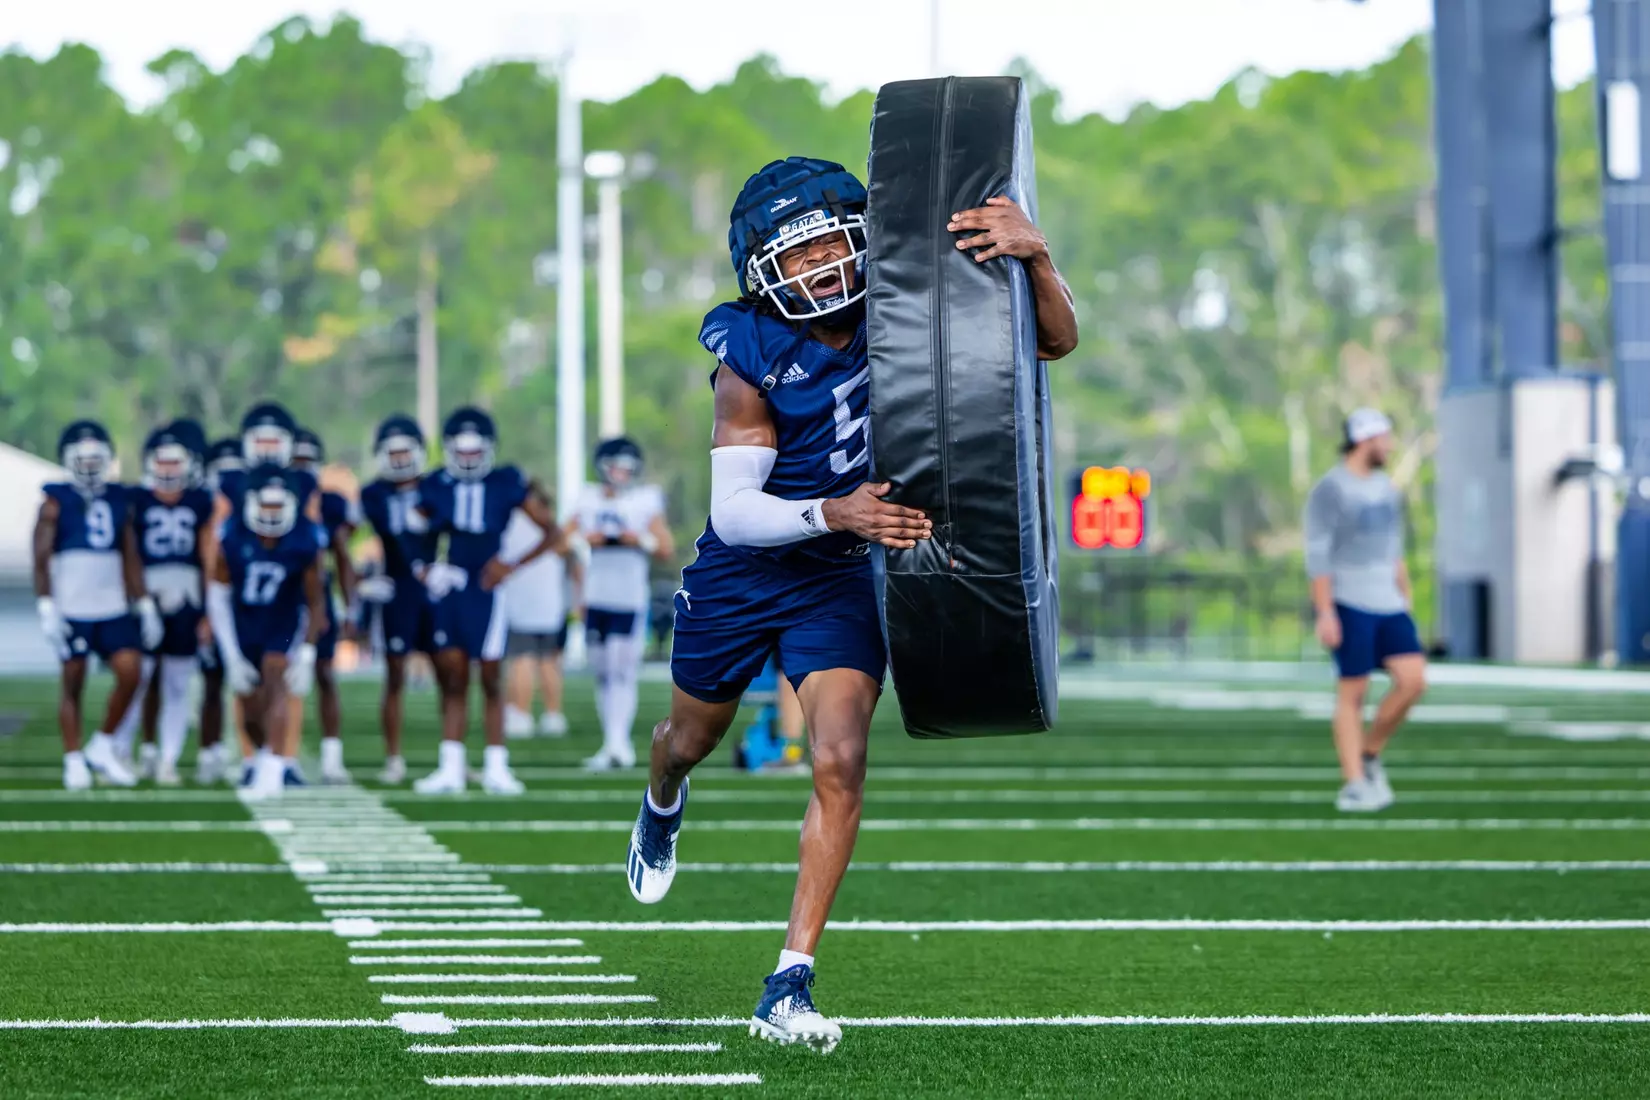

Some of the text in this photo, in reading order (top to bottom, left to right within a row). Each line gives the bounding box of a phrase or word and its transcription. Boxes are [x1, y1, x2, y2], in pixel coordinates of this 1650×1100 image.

[791, 216, 815, 231] GATA
[781, 372, 810, 384] adidas
[86, 499, 114, 549] 9
[144, 506, 197, 557] 26
[452, 483, 487, 534] 11
[243, 561, 286, 605] 17
